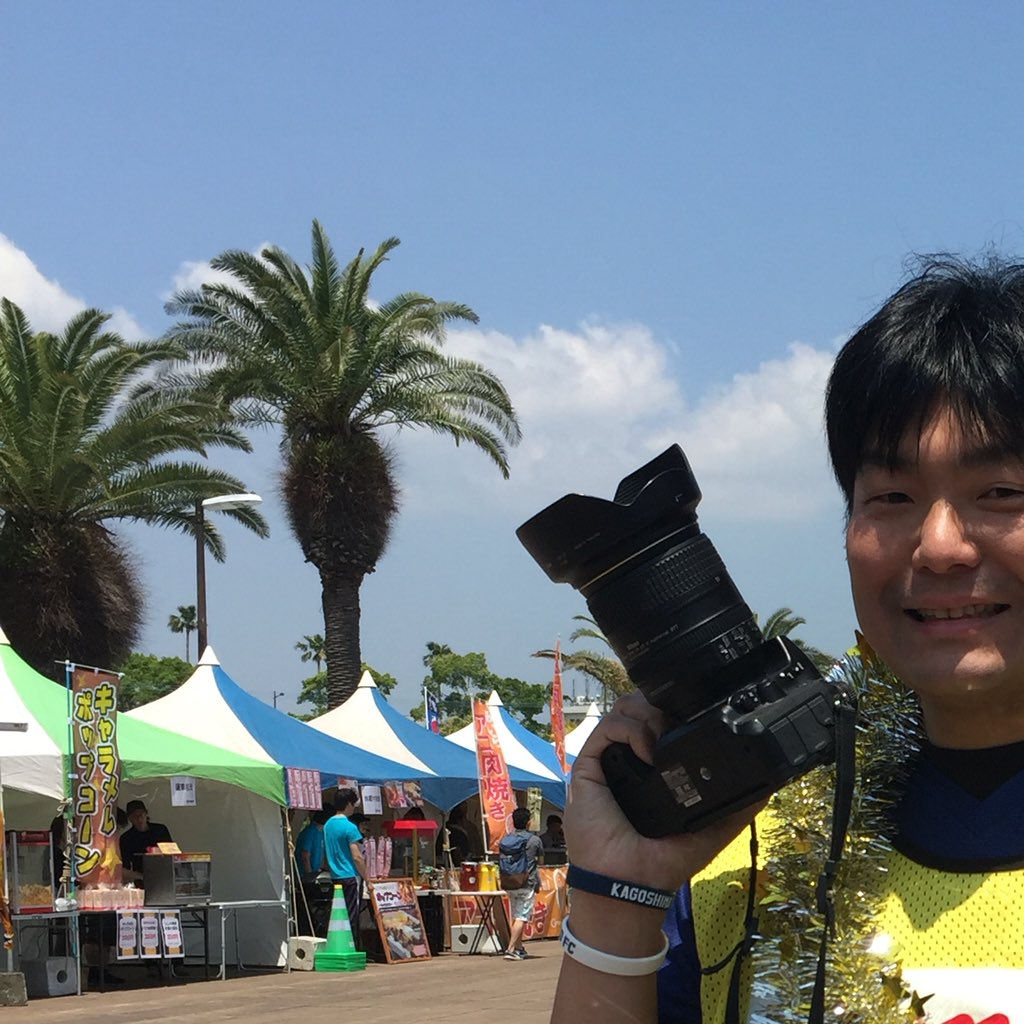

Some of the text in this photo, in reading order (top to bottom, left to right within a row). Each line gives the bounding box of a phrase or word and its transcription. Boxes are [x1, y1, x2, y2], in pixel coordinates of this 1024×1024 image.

[75, 690, 100, 877] ポップコーン
[95, 683, 119, 836] キャラメル
